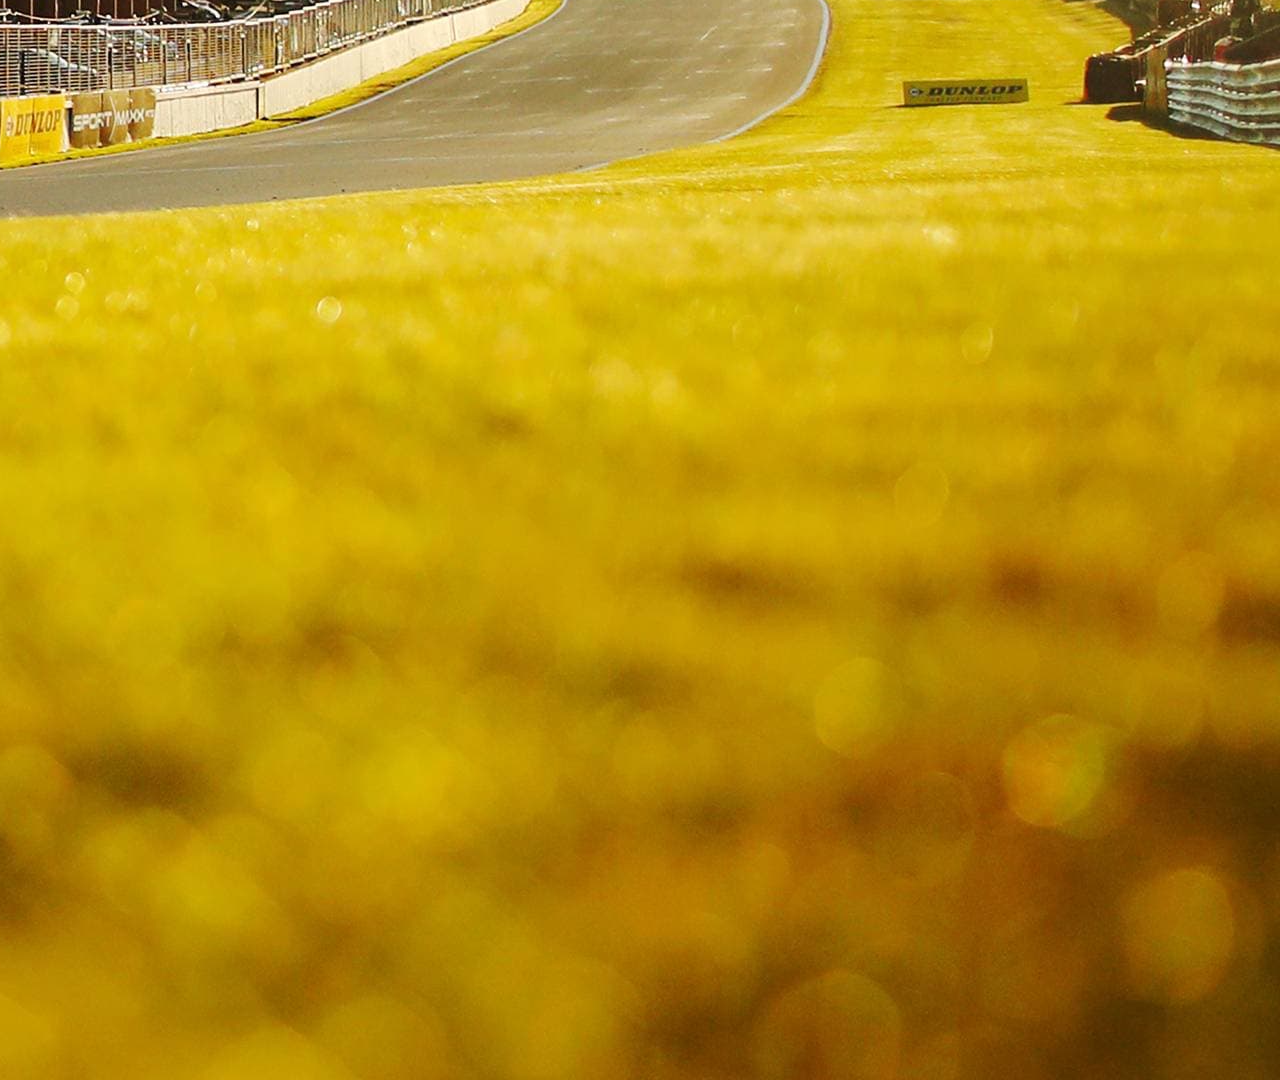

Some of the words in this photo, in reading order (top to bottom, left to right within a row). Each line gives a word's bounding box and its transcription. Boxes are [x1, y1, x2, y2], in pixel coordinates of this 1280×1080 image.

[928, 84, 1023, 96] DUNLOP
[15, 108, 62, 136] DUNLOP
[73, 112, 112, 132] SPORT
[114, 107, 145, 126] MAXX
